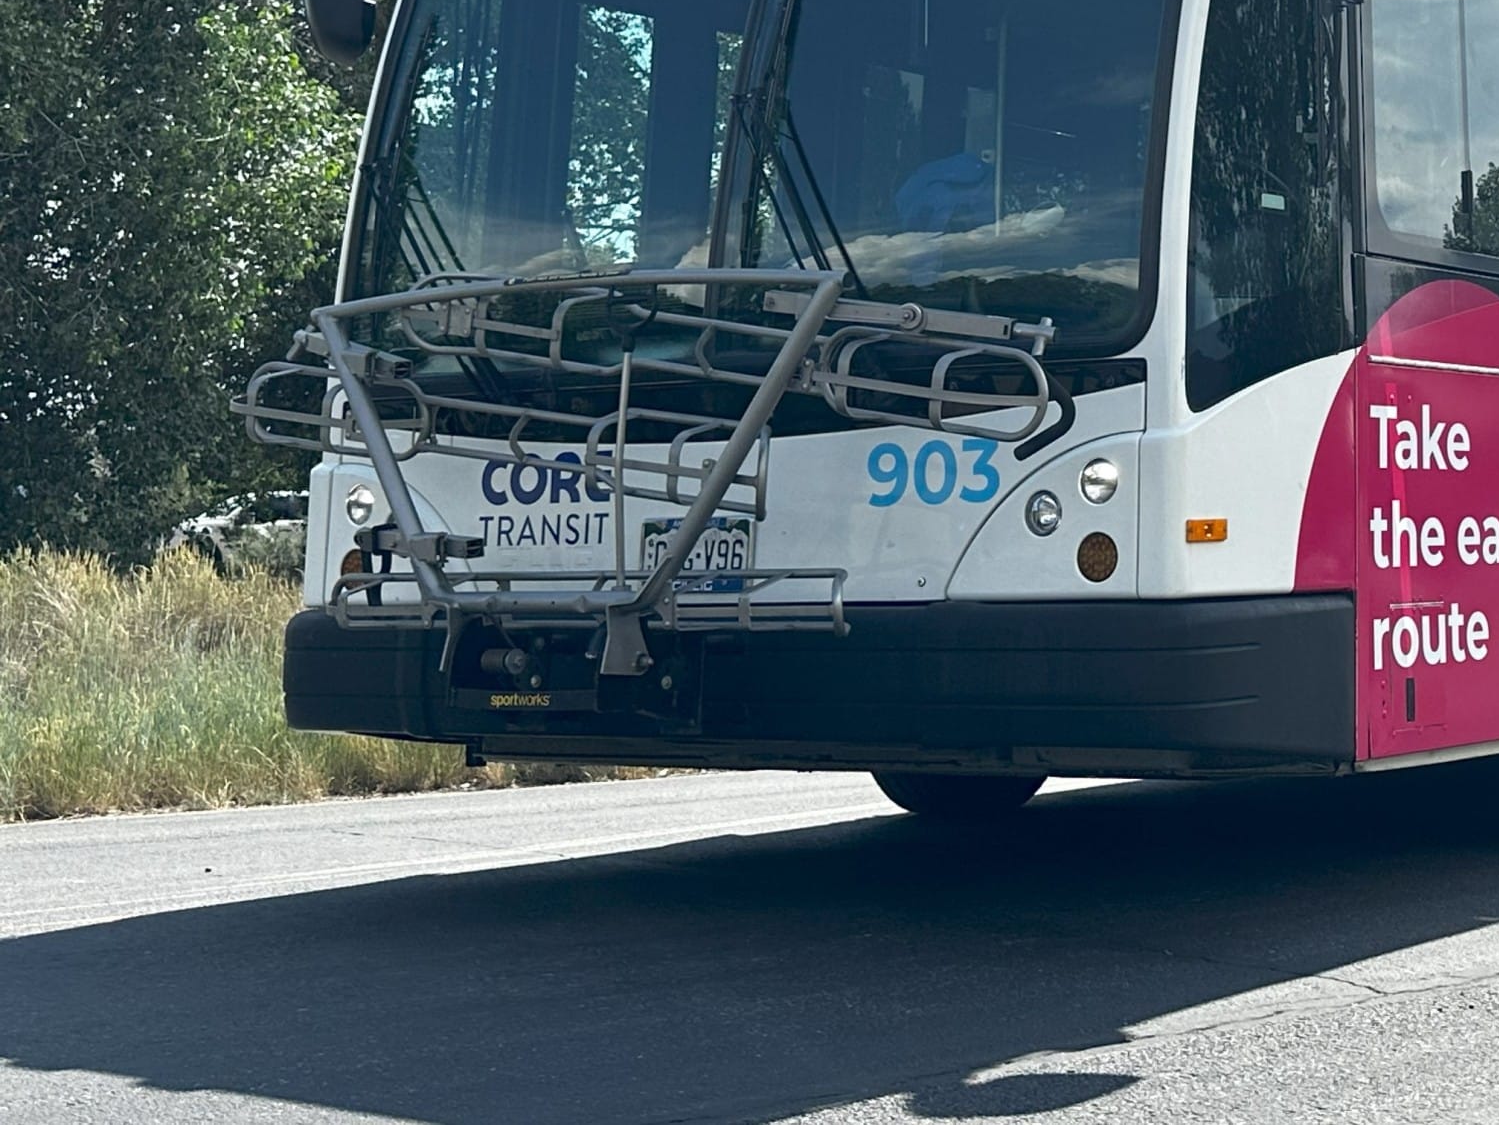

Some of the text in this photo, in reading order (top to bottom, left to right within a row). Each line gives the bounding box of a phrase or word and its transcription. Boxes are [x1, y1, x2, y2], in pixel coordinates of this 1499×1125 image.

[1369, 404, 1471, 471] Take
[864, 437, 1002, 508] 903
[479, 513, 609, 546] TRANSIT
[1369, 499, 1445, 569] the
[1373, 602, 1490, 670] route
[490, 693, 550, 708] sportworks
